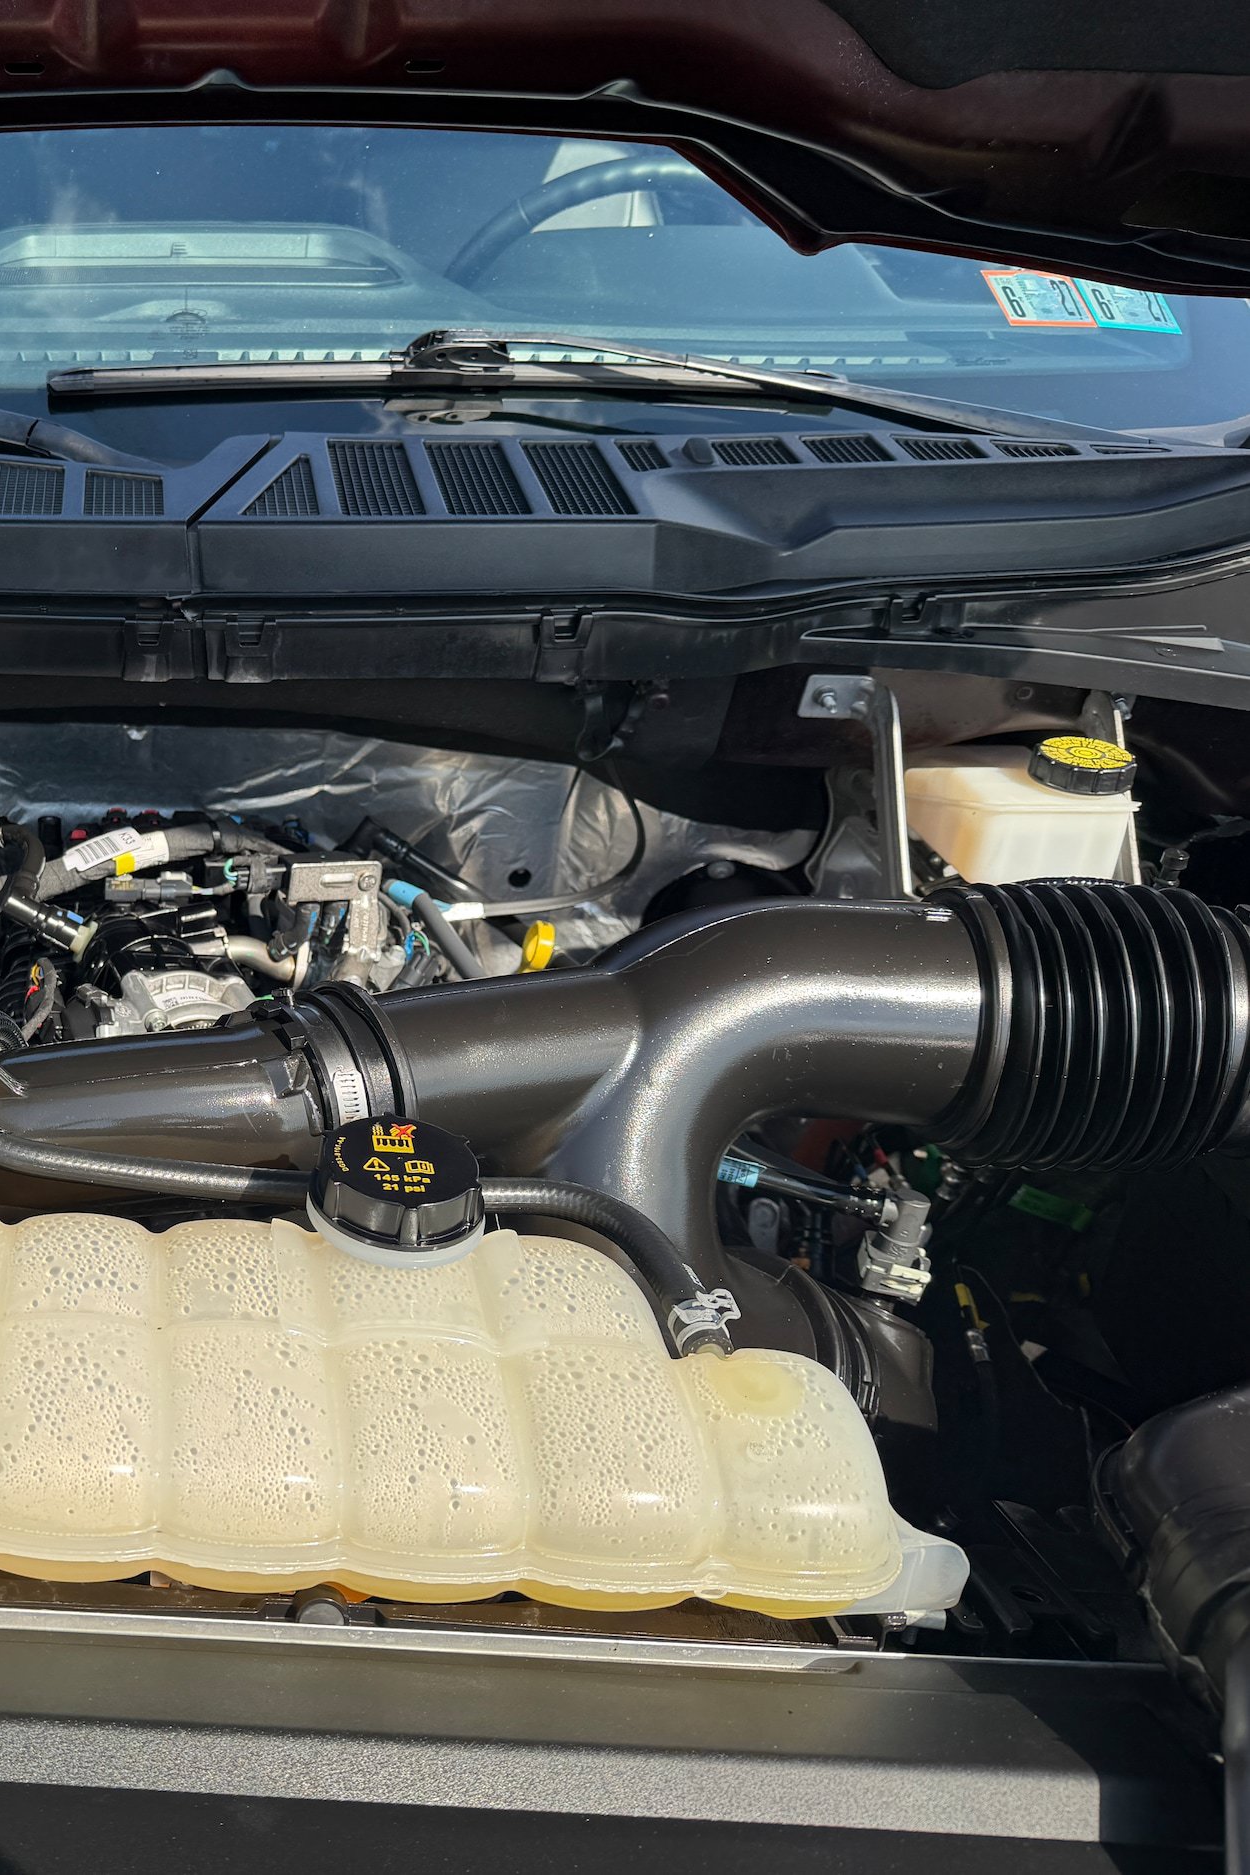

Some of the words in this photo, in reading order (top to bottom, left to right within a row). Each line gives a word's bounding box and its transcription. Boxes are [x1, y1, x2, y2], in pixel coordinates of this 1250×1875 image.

[1001, 286, 1026, 318] 6
[1050, 279, 1083, 320] 27
[1091, 288, 1115, 320] 6
[374, 1174, 400, 1182] 145
[403, 1175, 431, 1183] kPa
[382, 1183, 399, 1191] 21
[404, 1185, 426, 1193] psi
